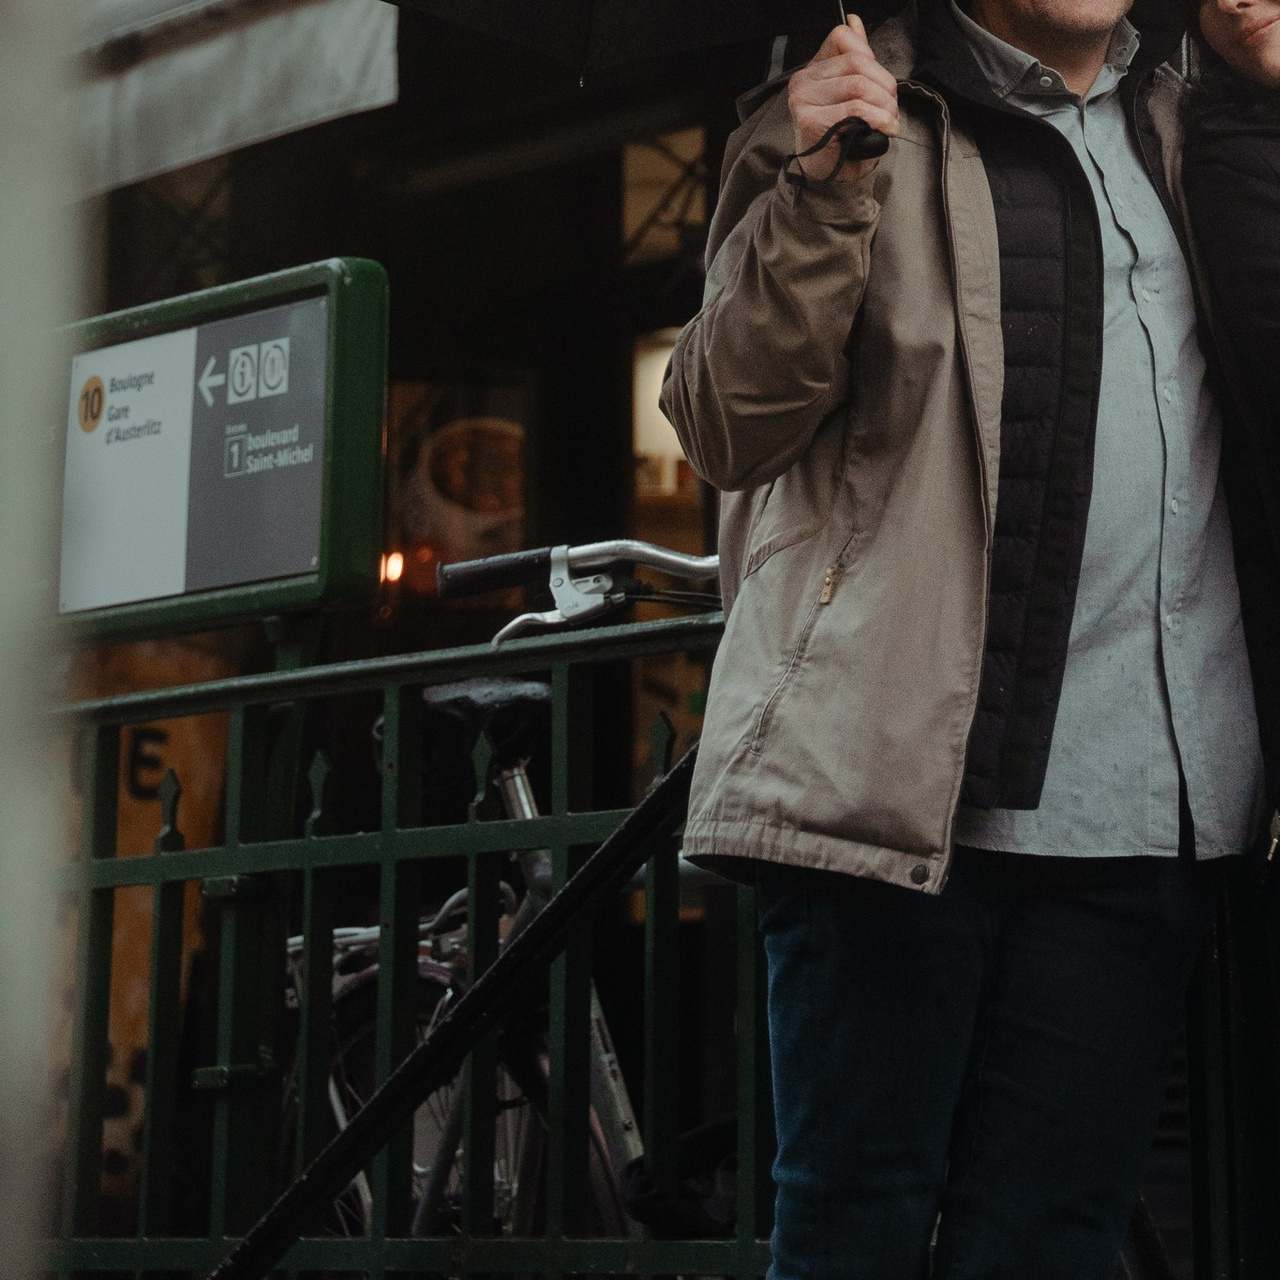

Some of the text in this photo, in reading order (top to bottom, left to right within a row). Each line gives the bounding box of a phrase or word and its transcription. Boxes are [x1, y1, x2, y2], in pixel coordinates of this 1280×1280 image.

[109, 372, 155, 393] Boulogne
[81, 387, 103, 423] 10
[107, 405, 129, 422] Gare
[105, 419, 162, 445] d'Austerlitz
[247, 424, 299, 450] boulevard
[230, 443, 240, 468] 1
[246, 443, 314, 473] Saint-Michel
